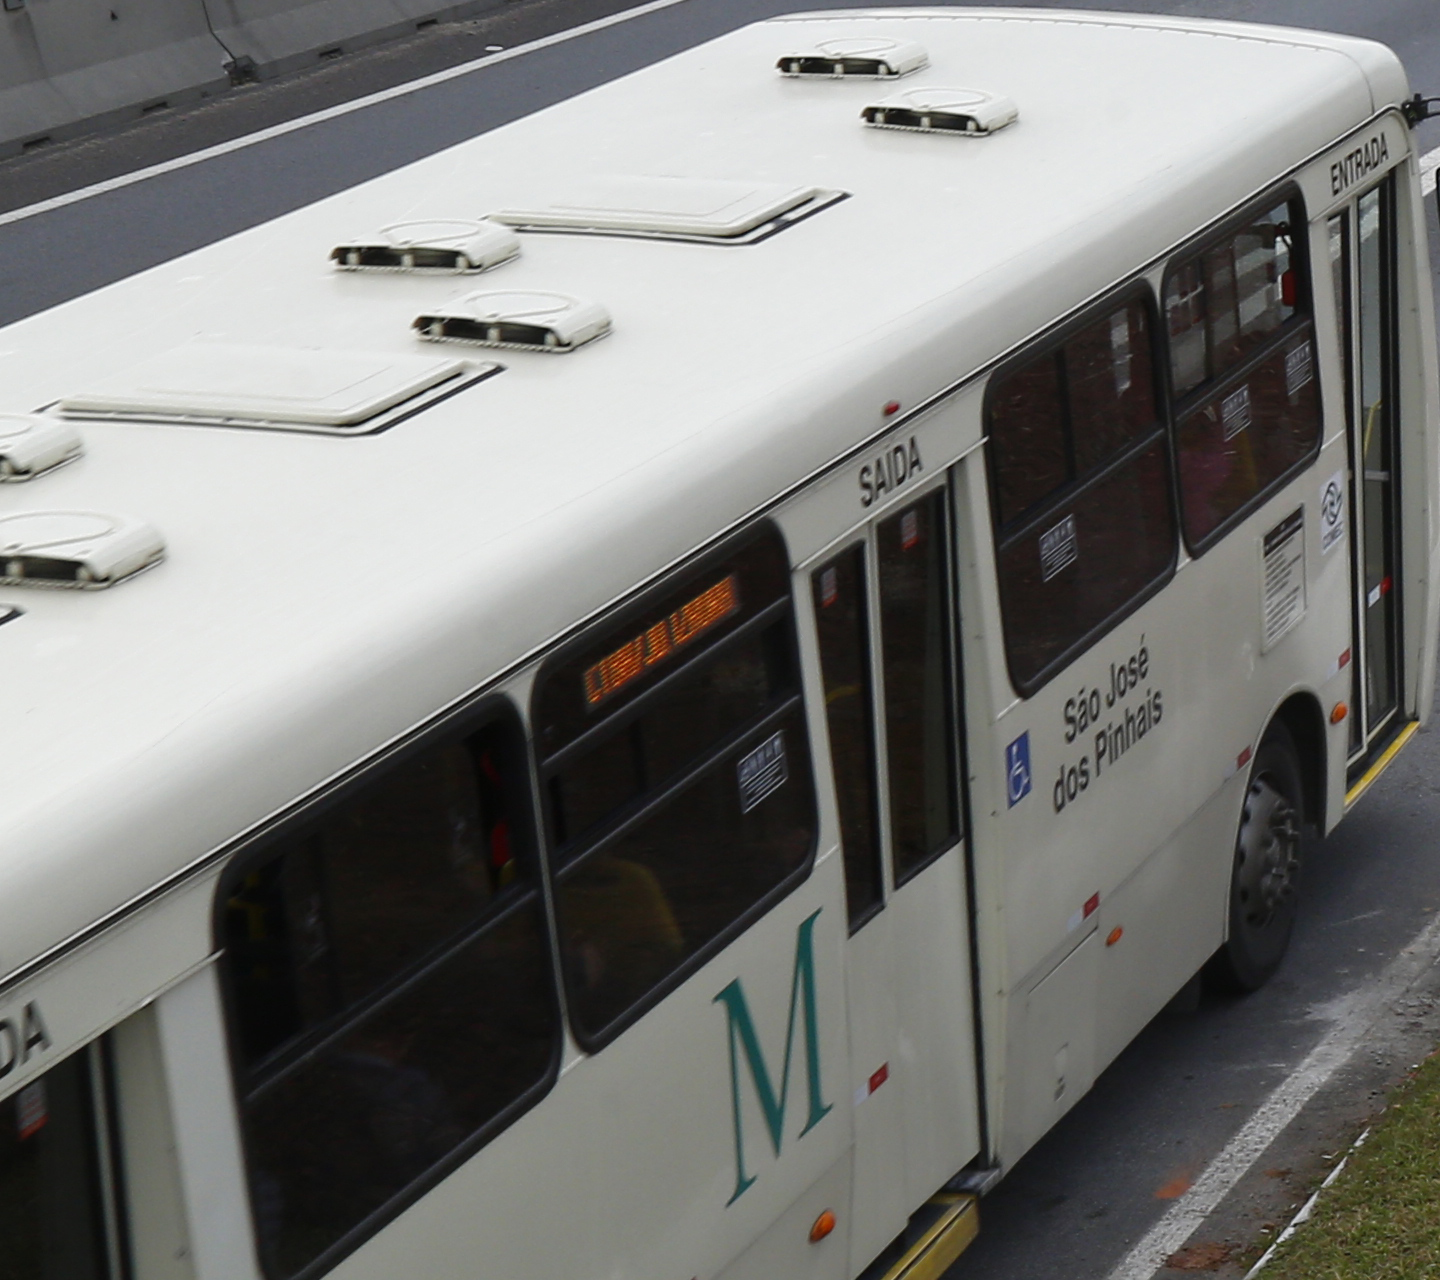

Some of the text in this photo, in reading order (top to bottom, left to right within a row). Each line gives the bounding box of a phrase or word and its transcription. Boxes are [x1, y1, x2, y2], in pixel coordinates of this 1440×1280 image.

[1331, 132, 1389, 196] ENTRADA
[1064, 633, 1149, 744] São José
[1053, 688, 1163, 815] dos Pinhais
[712, 906, 834, 1209] M
